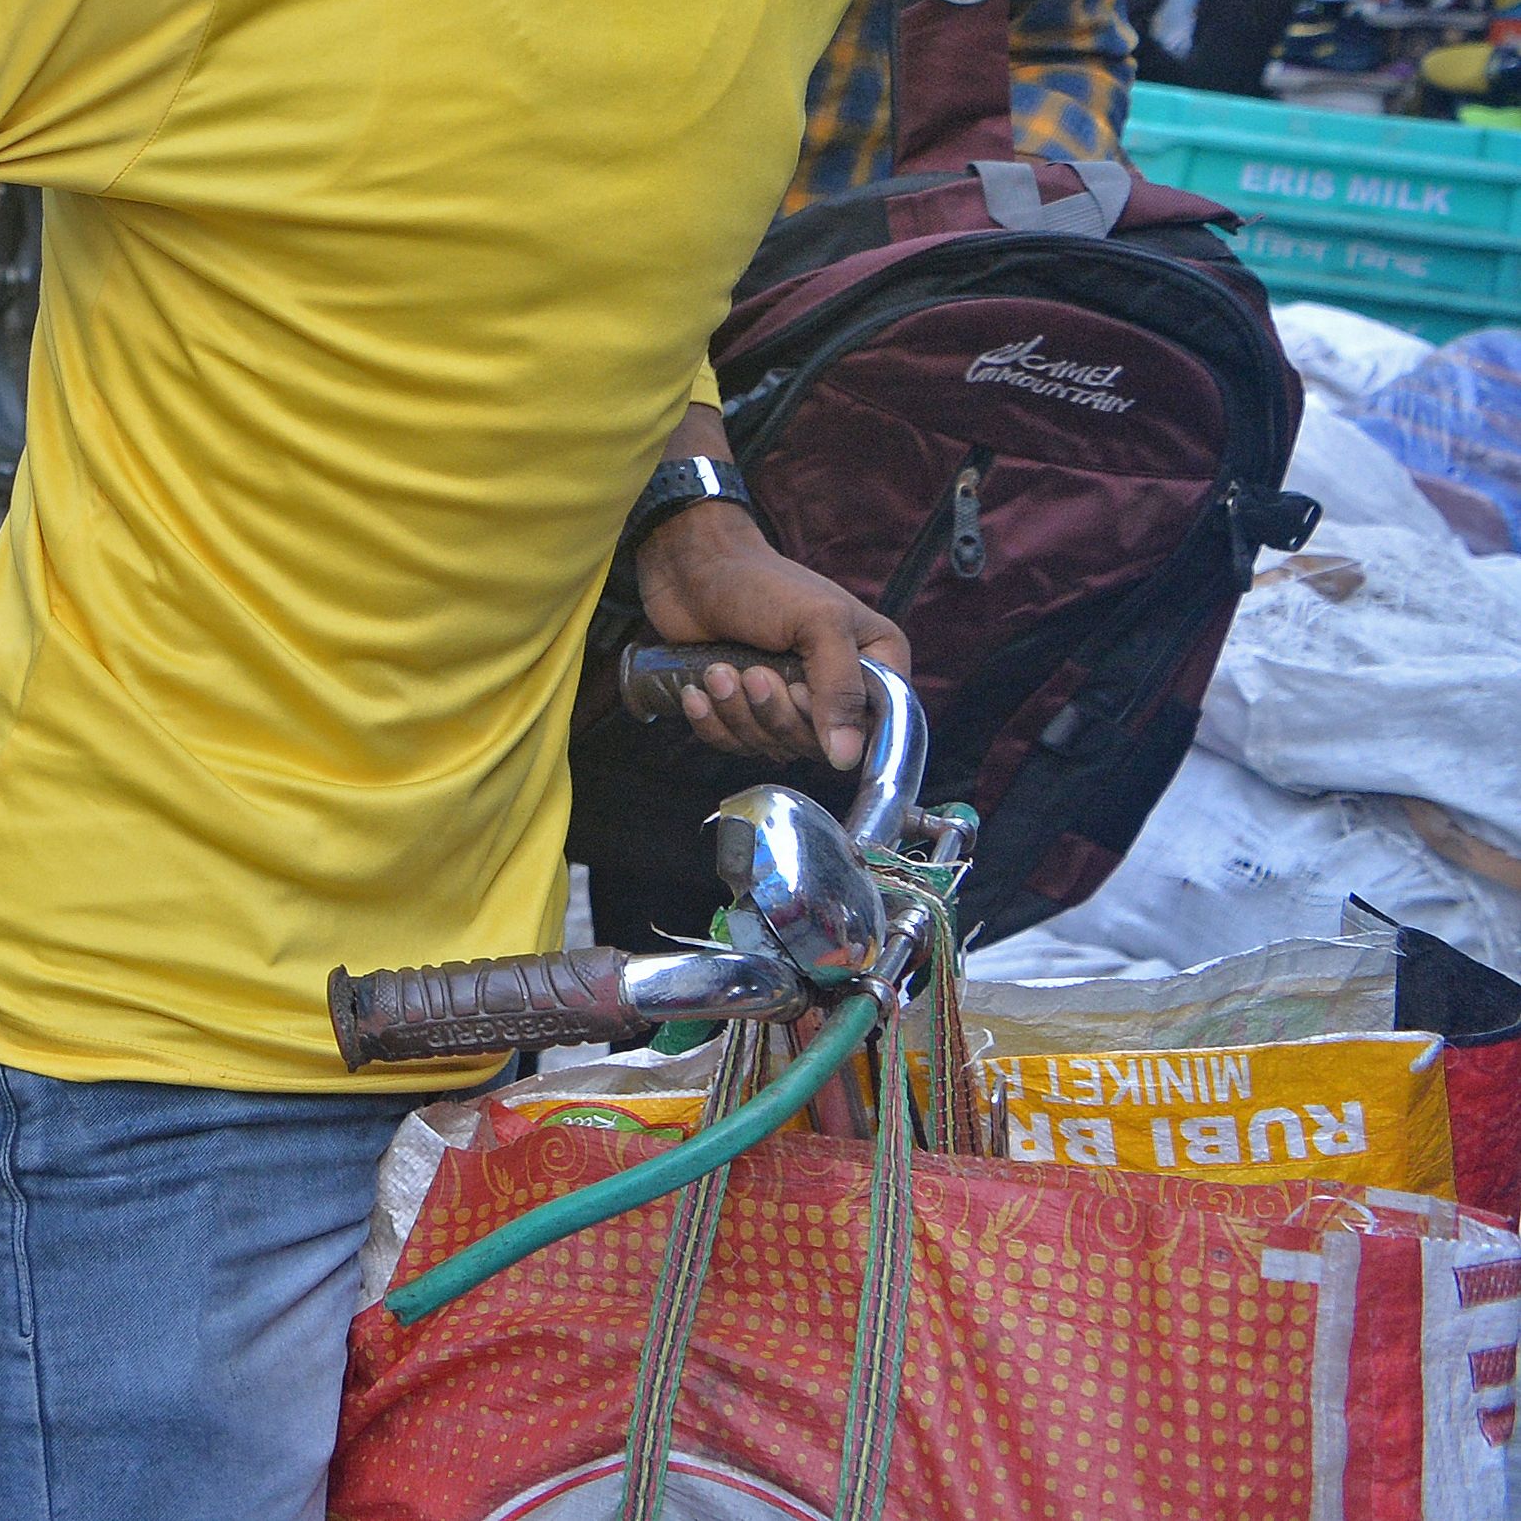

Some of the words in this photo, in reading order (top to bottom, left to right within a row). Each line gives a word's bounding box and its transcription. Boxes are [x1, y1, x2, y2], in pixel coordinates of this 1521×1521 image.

[1240, 163, 1336, 201] ERIS
[1347, 173, 1454, 216] MILK
[1042, 1054, 1252, 1106] MINIKET
[1151, 1100, 1369, 1168] RUBI
